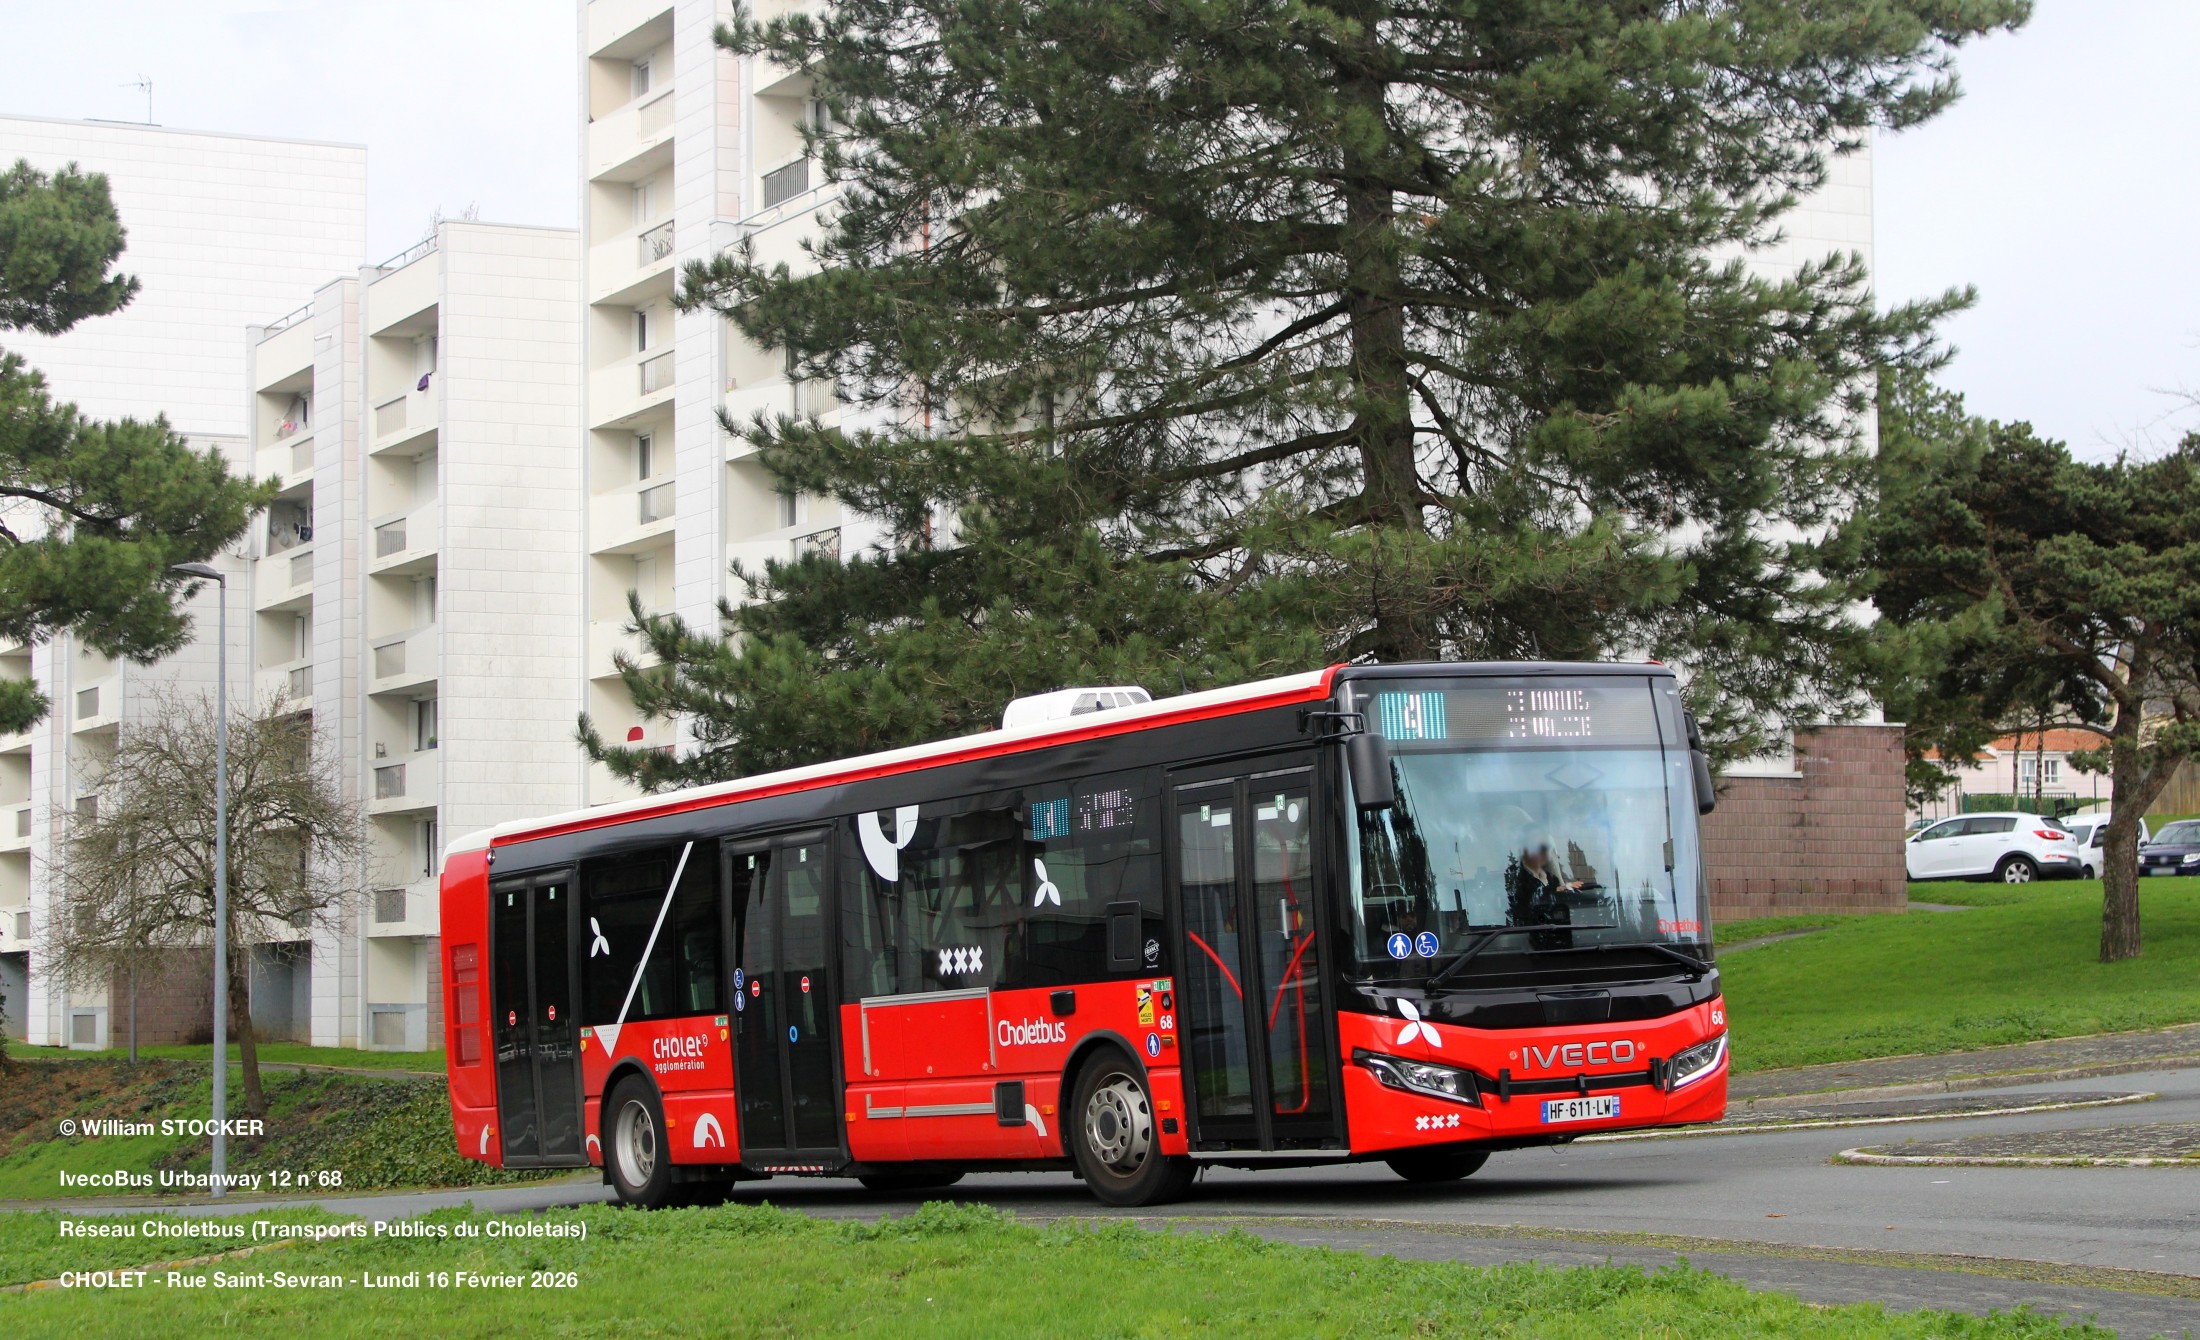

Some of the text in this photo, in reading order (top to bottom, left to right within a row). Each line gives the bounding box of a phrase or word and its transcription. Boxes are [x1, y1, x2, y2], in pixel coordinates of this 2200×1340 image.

[1160, 1014, 1173, 1030] 68
[1711, 1010, 1724, 1025] 68
[998, 1016, 1066, 1046] Choletbus
[1522, 1039, 1635, 1070] IVECO
[655, 1059, 705, 1073] agglomération
[1550, 1099, 1611, 1119] HF-611-LW
